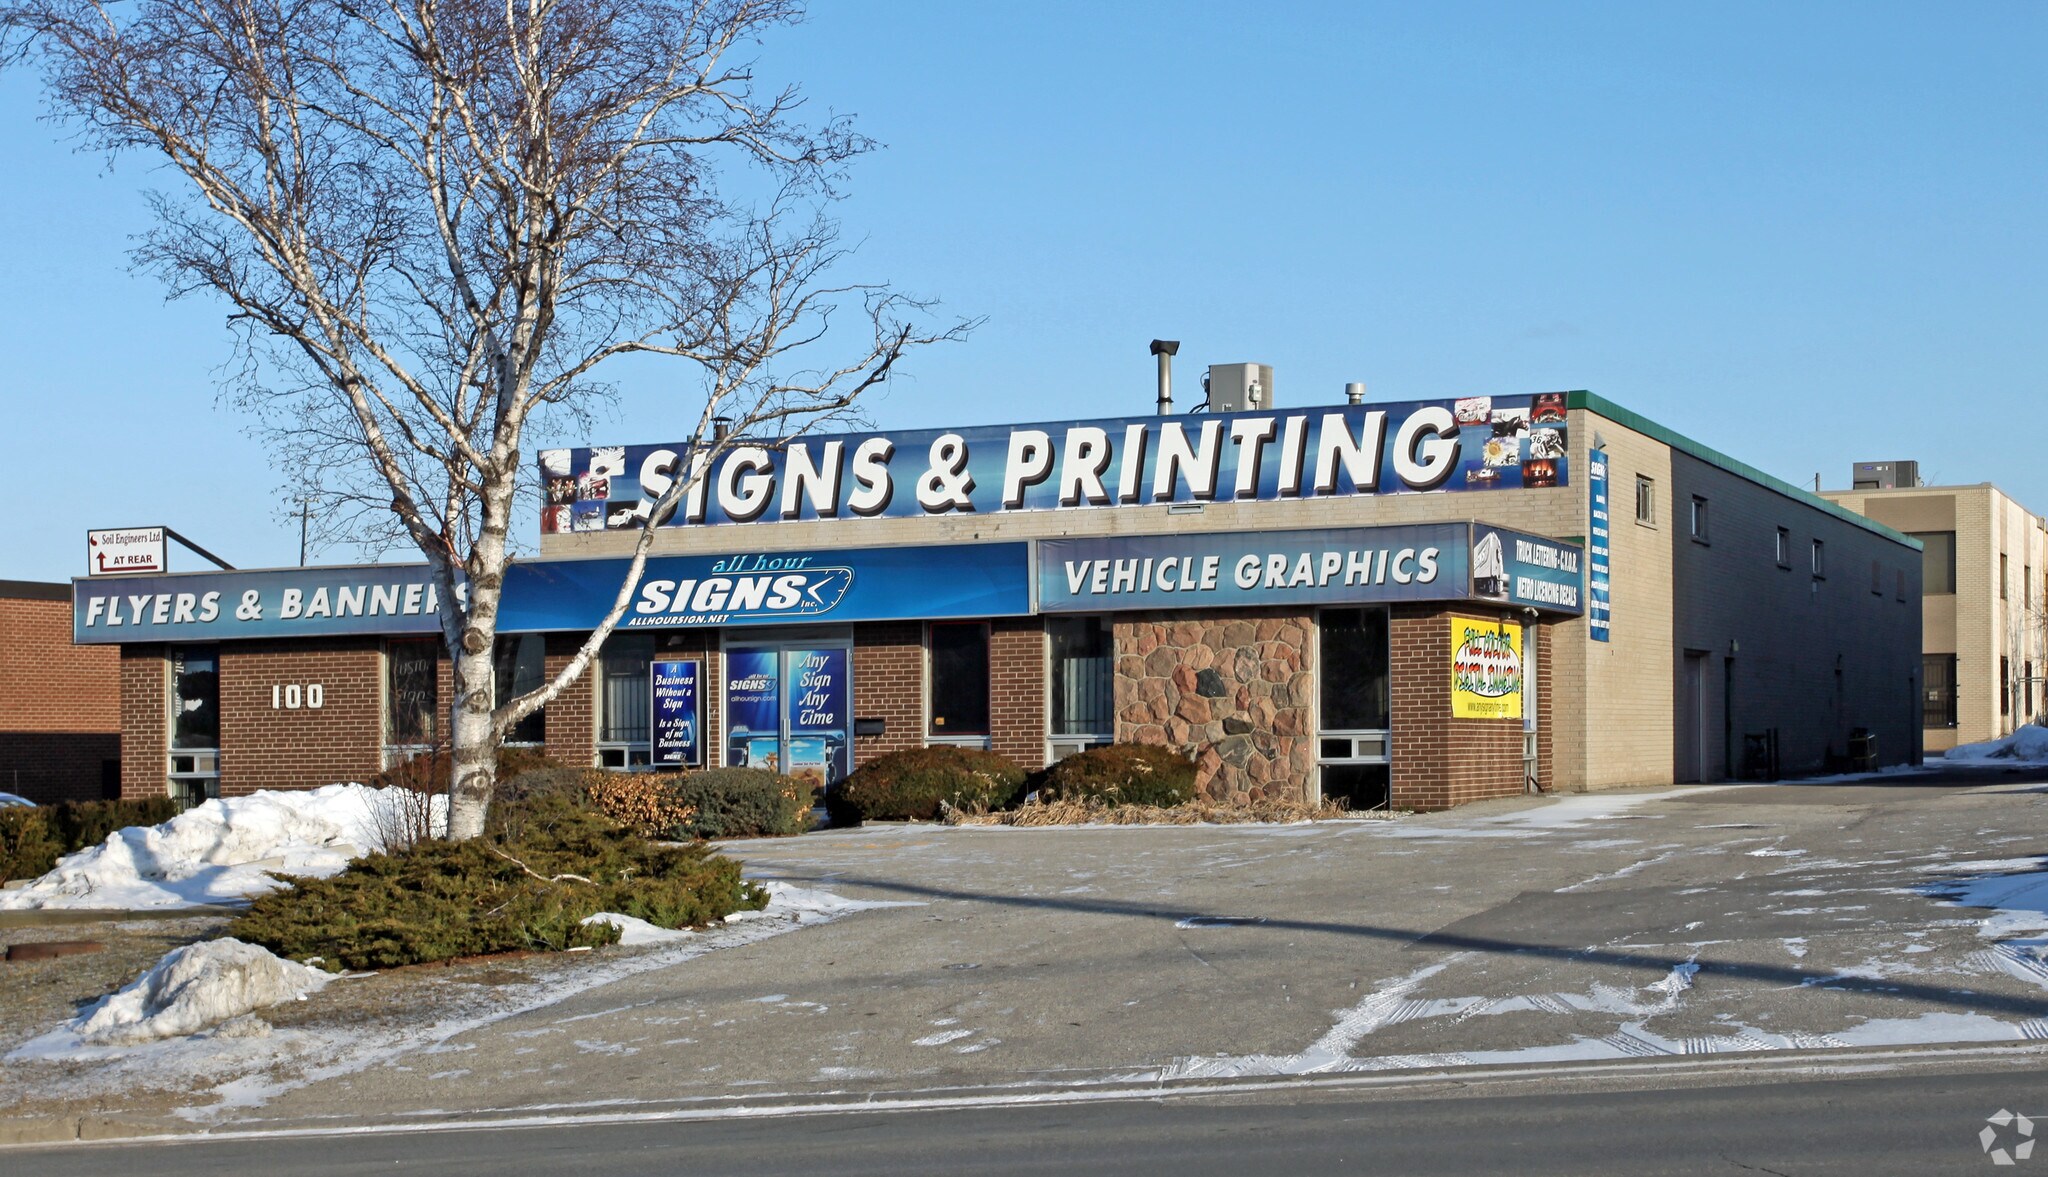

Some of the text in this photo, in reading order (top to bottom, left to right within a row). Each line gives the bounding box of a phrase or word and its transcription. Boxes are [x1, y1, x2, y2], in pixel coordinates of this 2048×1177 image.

[636, 406, 1461, 529] SIGNS & PRINTING
[102, 531, 162, 546] Soil Engineers Ltd.
[113, 554, 152, 565] AT REAR
[1516, 539, 1533, 565] TRUCK
[1533, 543, 1558, 570] LETTERING
[712, 553, 812, 573] all hour
[1064, 546, 1440, 594] VEHICLE GRAPHICS
[635, 573, 808, 614] SIGNS
[1516, 576, 1534, 600] METRO
[1559, 584, 1578, 607] DECALS
[86, 591, 221, 628] FLYERS
[235, 588, 263, 621] &
[800, 599, 818, 608] Inc.
[628, 614, 729, 626] ALLHOURSIGN.NET
[670, 664, 678, 673] A
[798, 651, 830, 672] Any
[655, 674, 694, 686] Business
[729, 679, 767, 691] SIGNS
[799, 671, 832, 693] Sign
[272, 683, 324, 710] 100
[655, 687, 692, 698] Without a
[798, 690, 829, 711] Any
[663, 697, 684, 712] Sign
[659, 718, 667, 728] Is
[673, 718, 690, 731] Sign
[800, 709, 834, 726] Time
[665, 727, 684, 741] of no
[658, 739, 691, 749] Business
